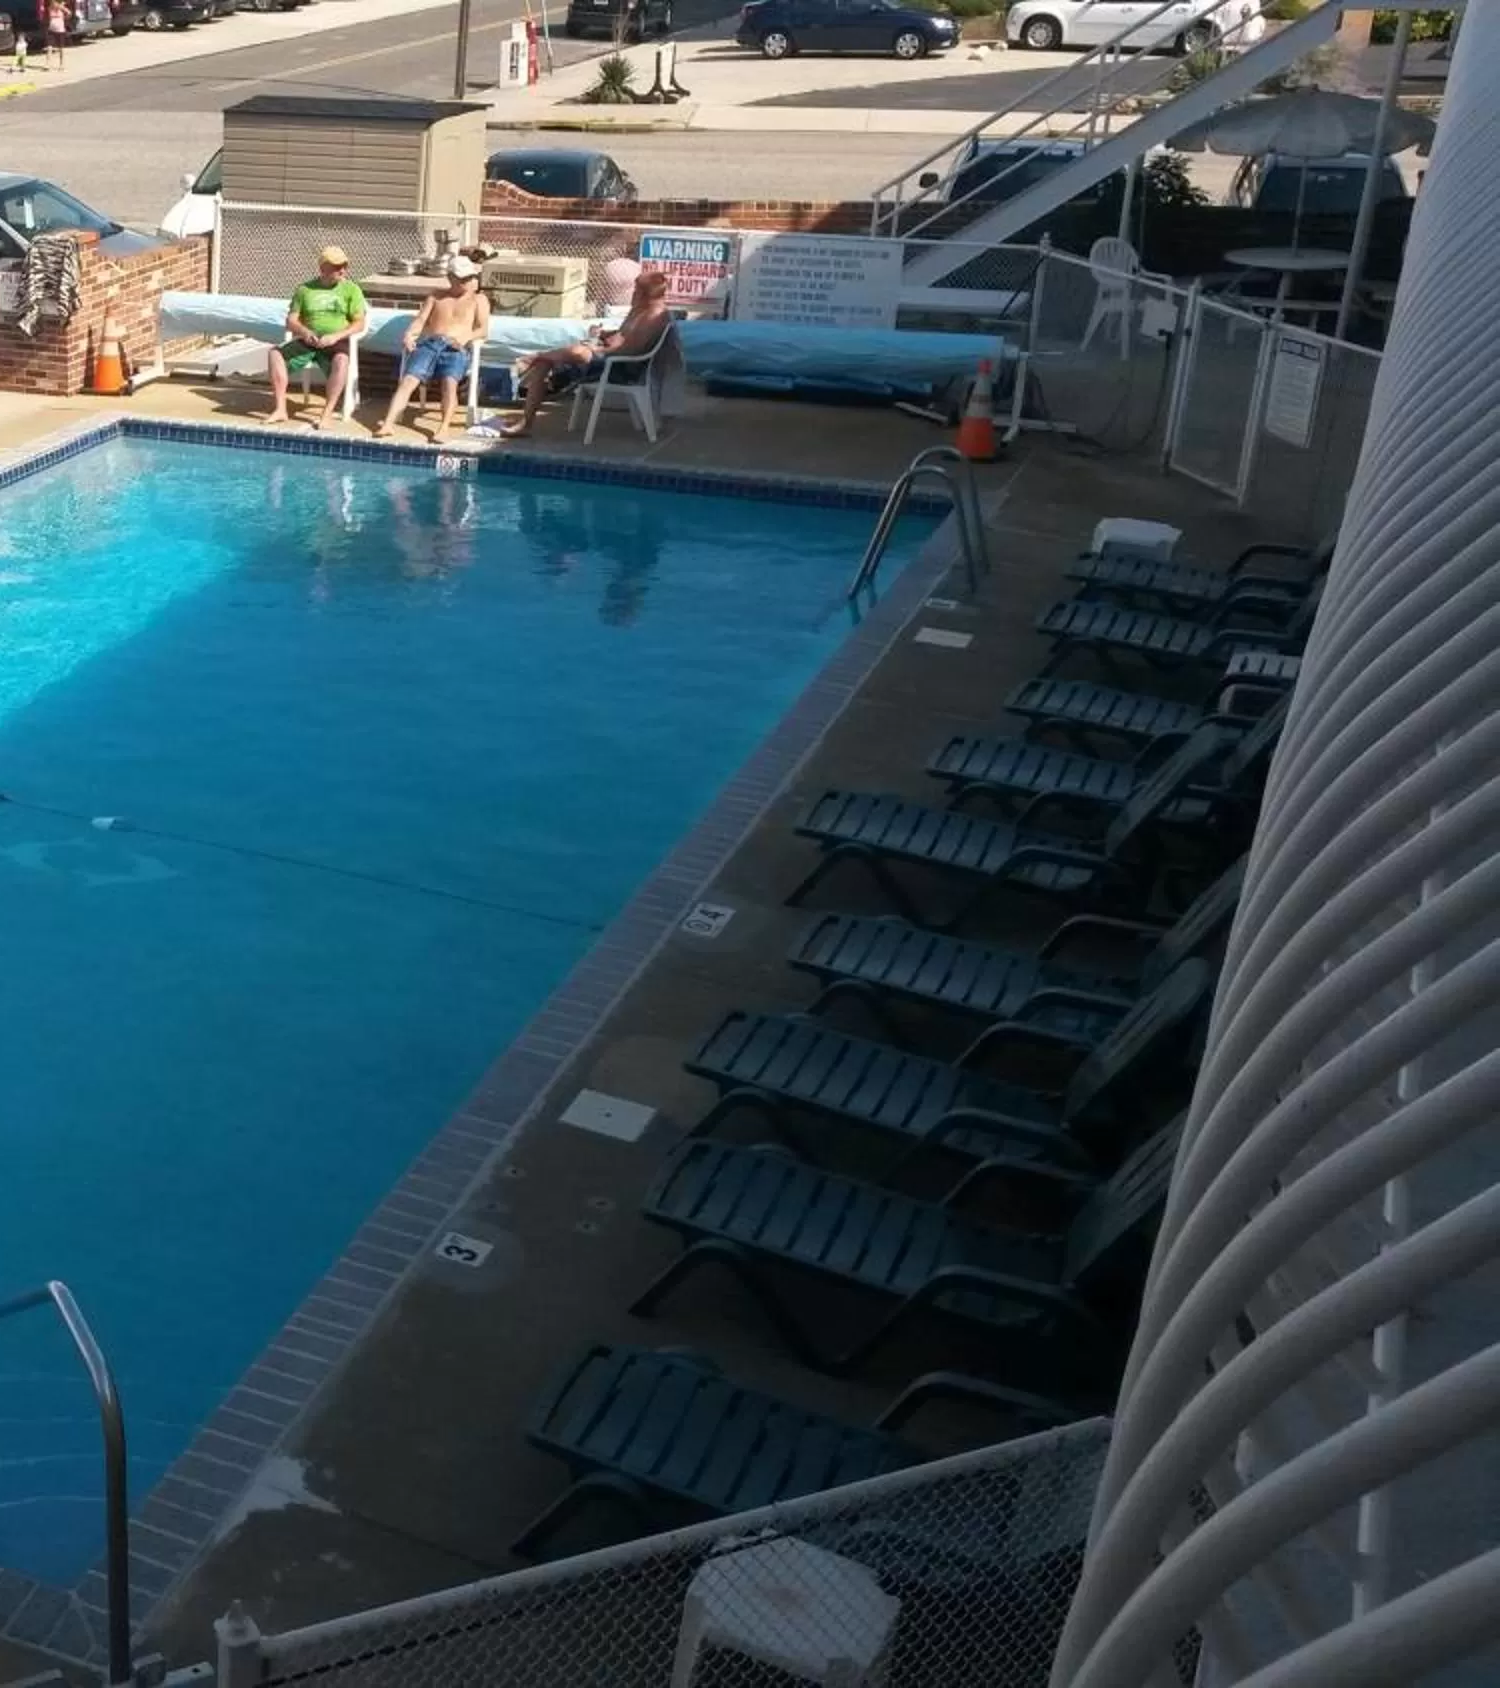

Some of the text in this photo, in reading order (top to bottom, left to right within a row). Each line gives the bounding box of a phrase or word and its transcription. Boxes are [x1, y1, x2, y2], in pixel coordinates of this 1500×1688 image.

[649, 239, 724, 261] WARNING
[661, 261, 727, 278] LIFEGUARD
[677, 278, 708, 293] DUTY
[444, 1245, 478, 1261] 3
